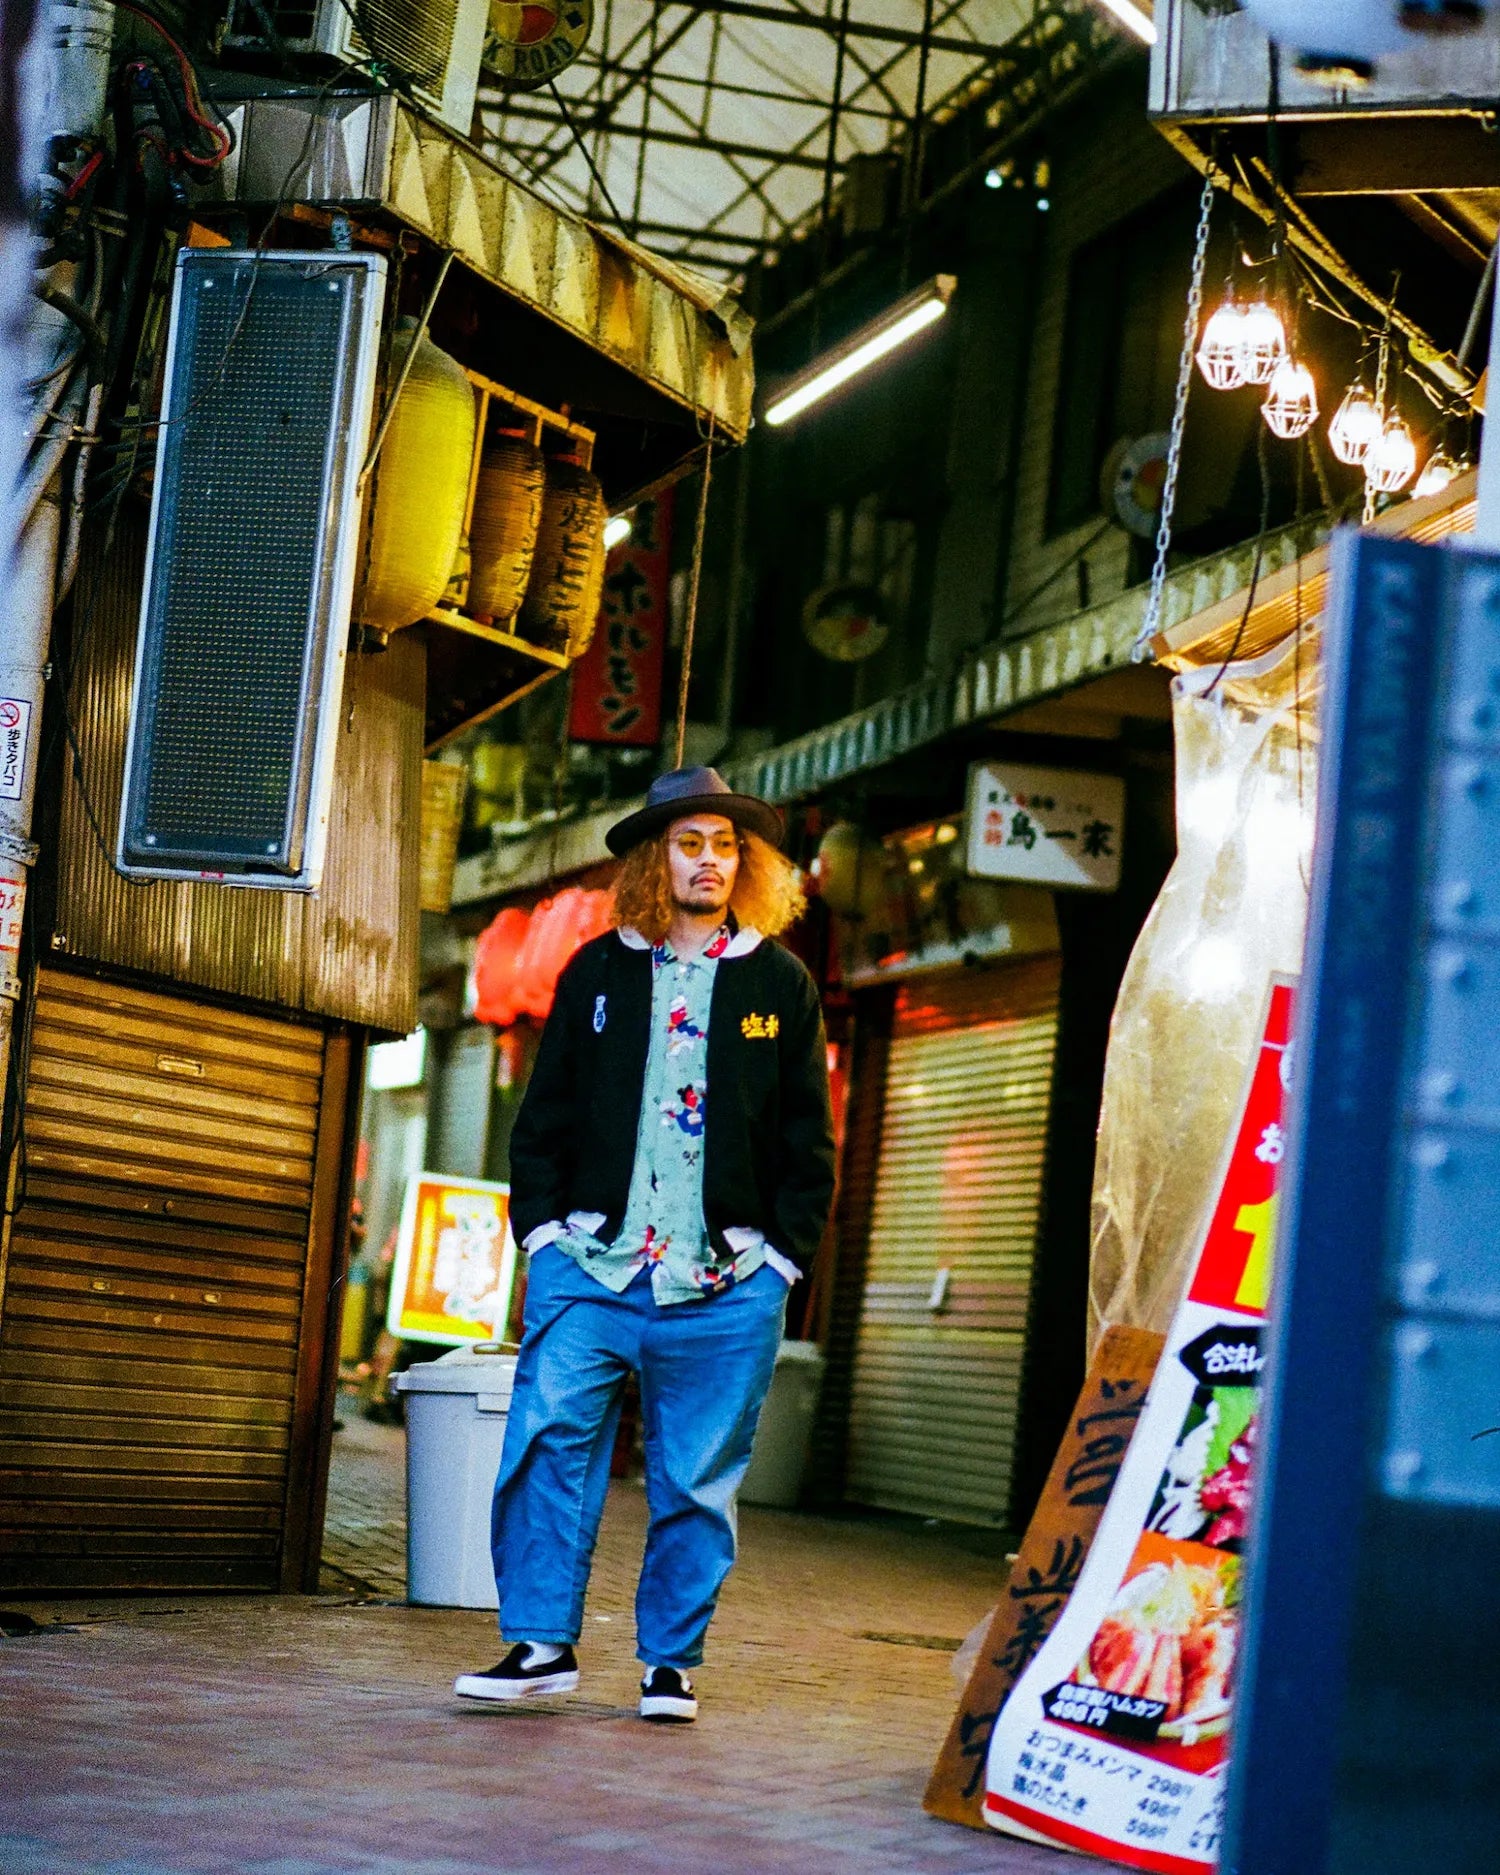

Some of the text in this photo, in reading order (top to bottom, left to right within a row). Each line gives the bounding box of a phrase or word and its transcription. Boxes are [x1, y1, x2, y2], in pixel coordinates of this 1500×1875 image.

[515, 37, 573, 74] ROAD
[3, 729, 21, 786] 歩きタバコ
[1026, 1729, 1142, 1781] おつまみメンマ
